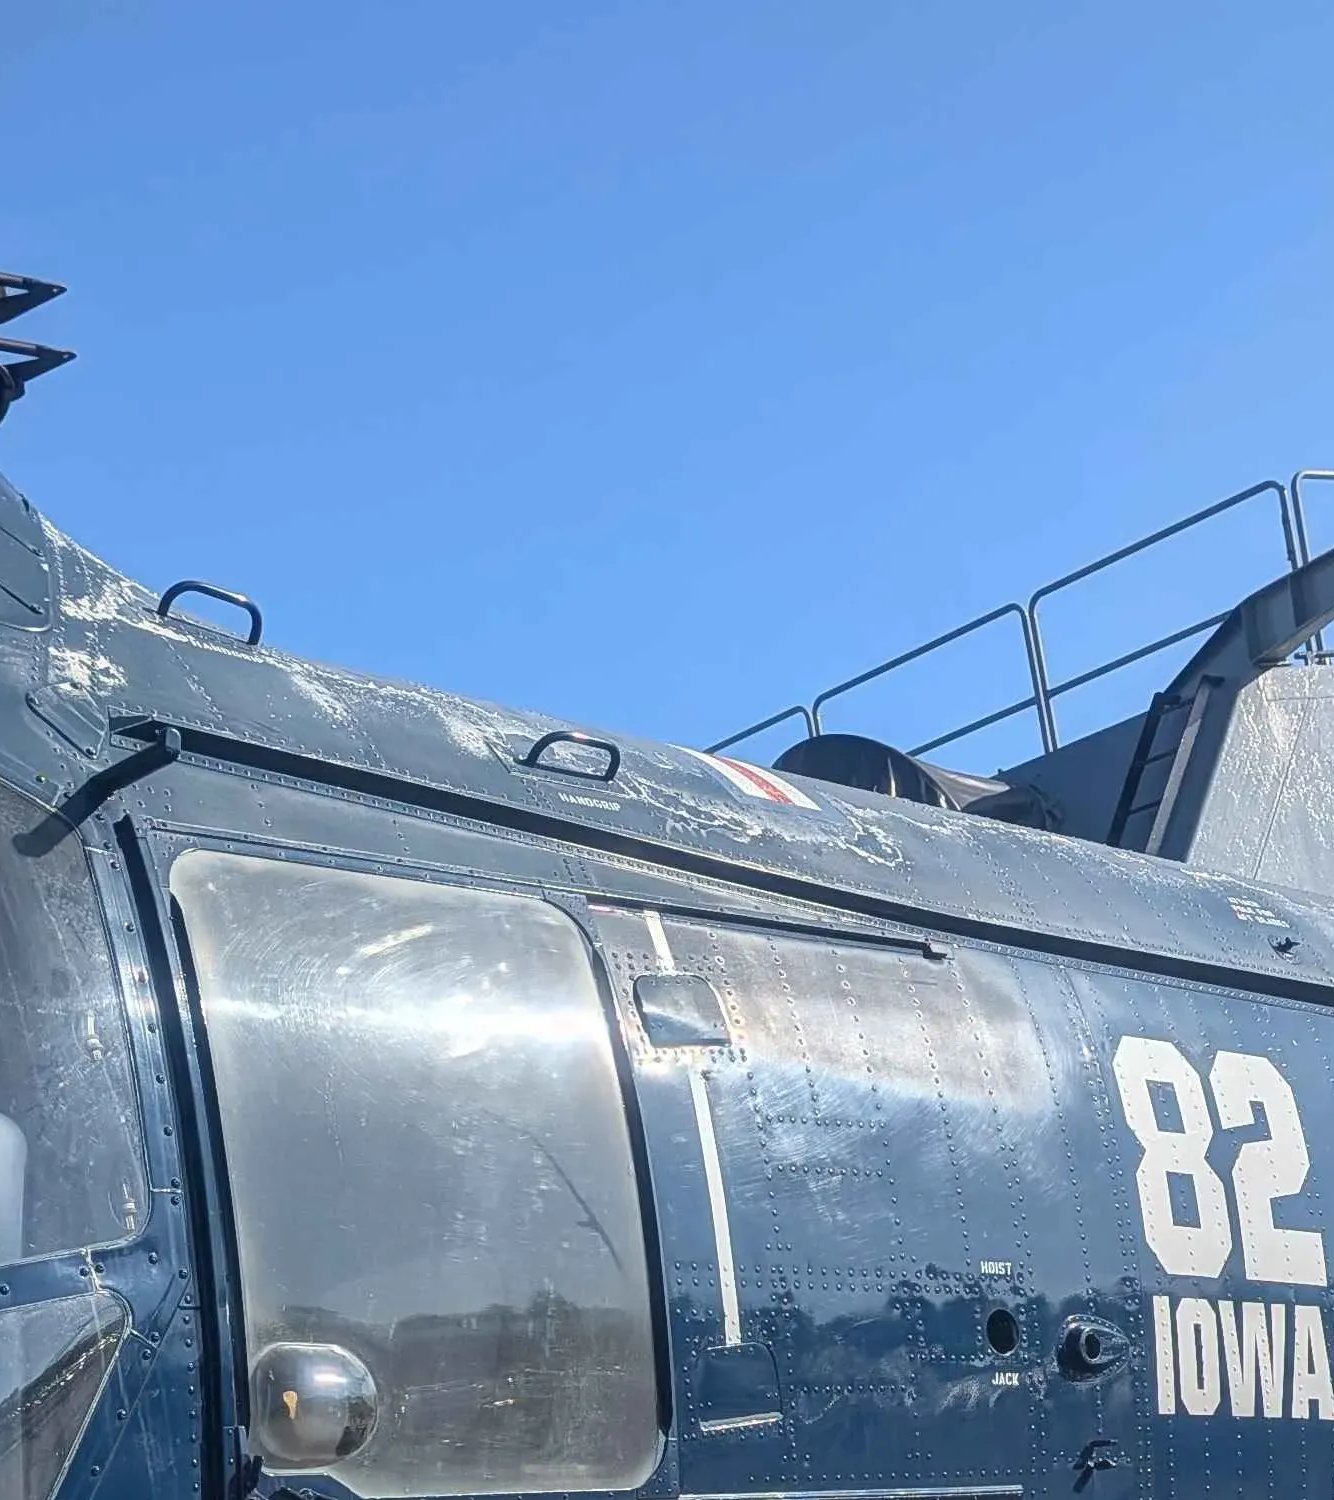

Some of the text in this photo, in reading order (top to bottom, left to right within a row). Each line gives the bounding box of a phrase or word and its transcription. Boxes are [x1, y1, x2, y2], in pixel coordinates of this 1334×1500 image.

[557, 792, 621, 812] HANDGRIP
[1112, 1035, 1327, 1287] 82
[980, 1261, 1012, 1275] HOIST
[992, 1371, 1019, 1386] JACK
